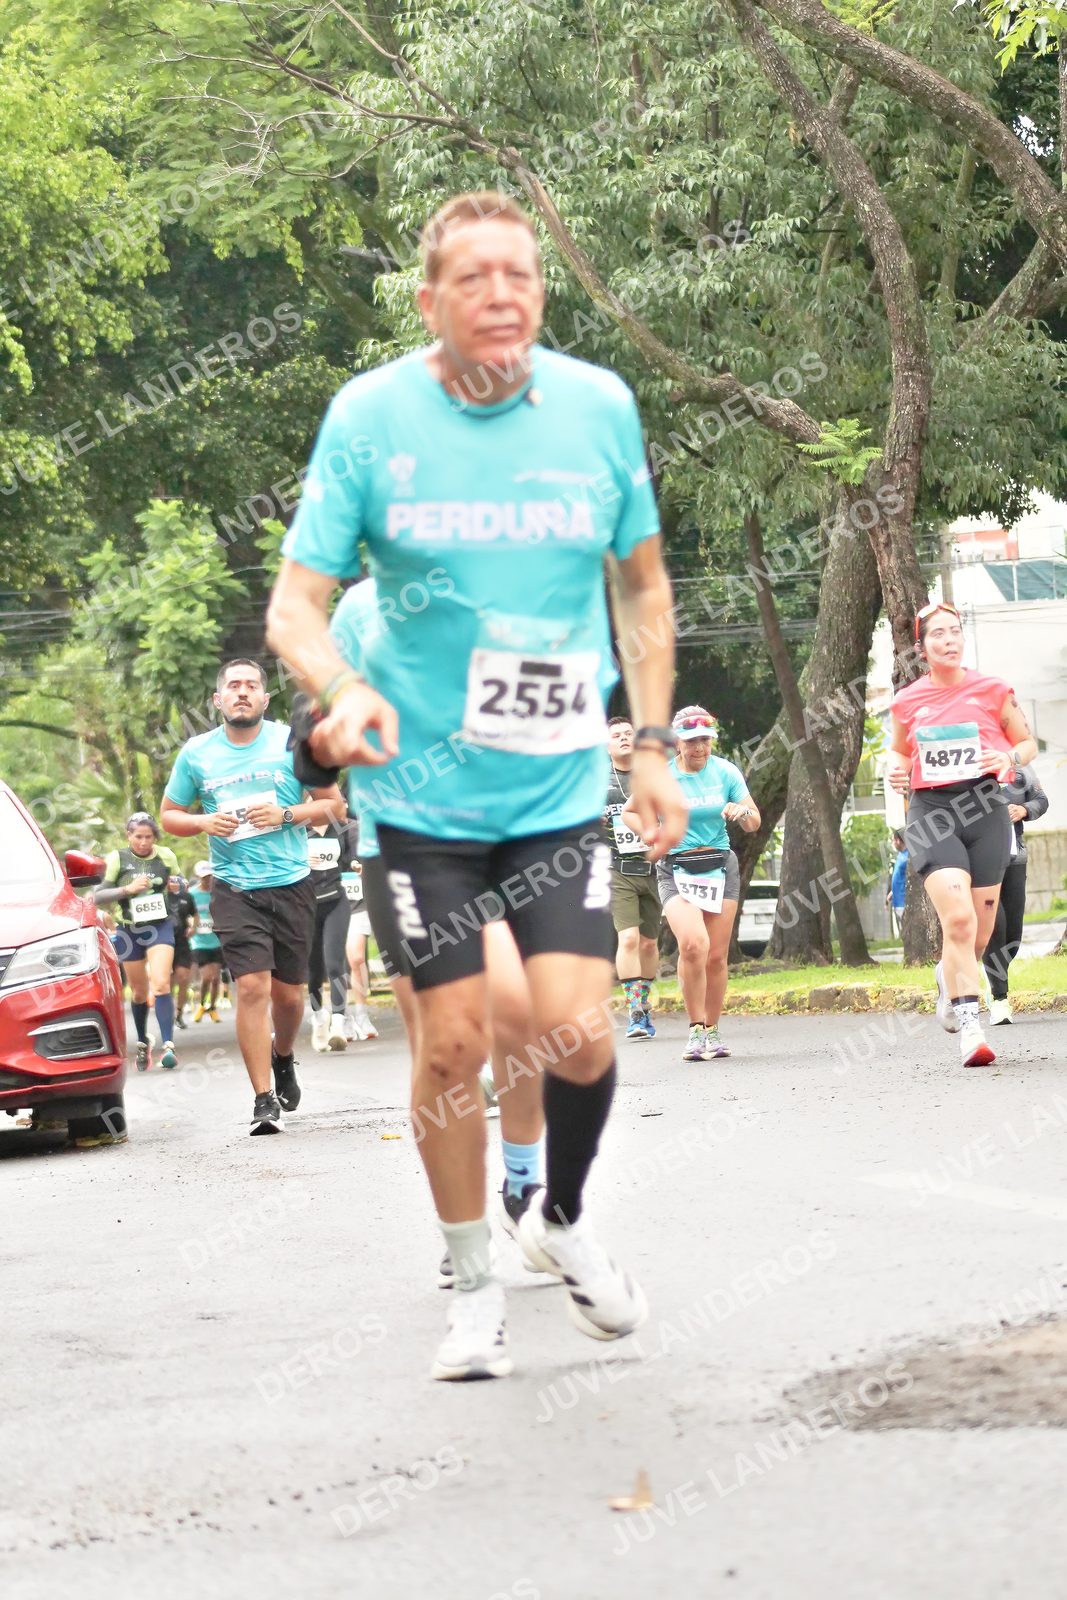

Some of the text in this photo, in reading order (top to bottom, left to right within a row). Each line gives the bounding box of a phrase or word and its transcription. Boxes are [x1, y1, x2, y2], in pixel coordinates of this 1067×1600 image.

[386, 502, 596, 541] PERDURA
[479, 678, 587, 719] 2554
[925, 747, 977, 768] 4872
[135, 901, 163, 913] 6855
